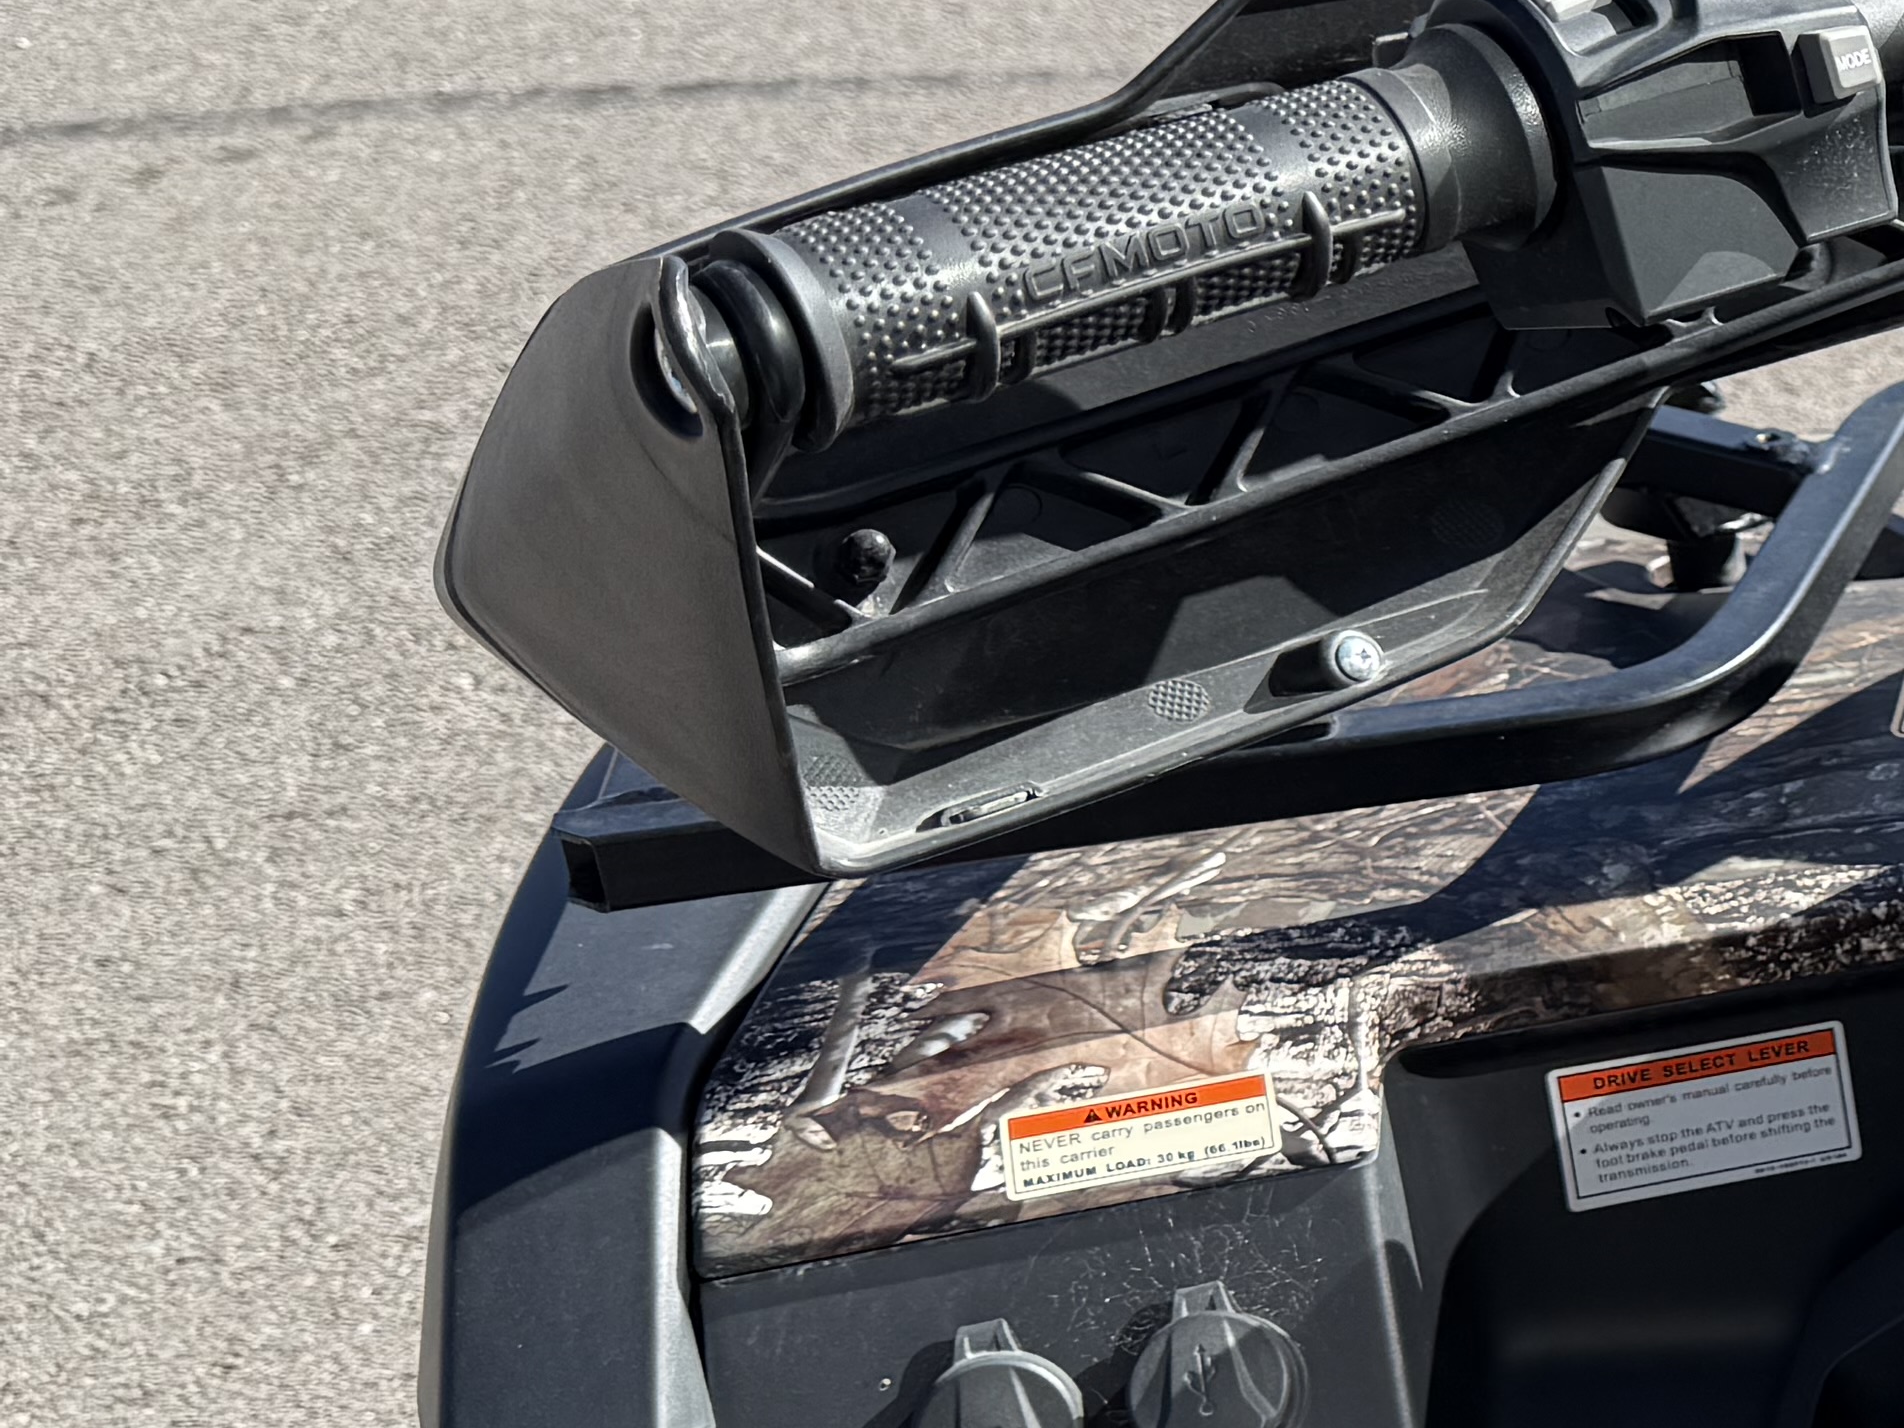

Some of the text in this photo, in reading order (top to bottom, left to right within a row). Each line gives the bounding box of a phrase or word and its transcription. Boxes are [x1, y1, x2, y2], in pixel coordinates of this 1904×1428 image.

[1834, 47, 1872, 73] MODE
[1023, 202, 1266, 301] CFMOTO
[1593, 1040, 1810, 1090] DRIVE SELECT LEVER
[1105, 1092, 1197, 1118] WARNING
[1018, 1102, 1265, 1154] NEVER carry passengers on
[1019, 1145, 1114, 1171] this carrier
[1022, 1165, 1097, 1188] MAXIMUM
[1156, 1151, 1173, 1163] 30
[1177, 1150, 1195, 1161] kg
